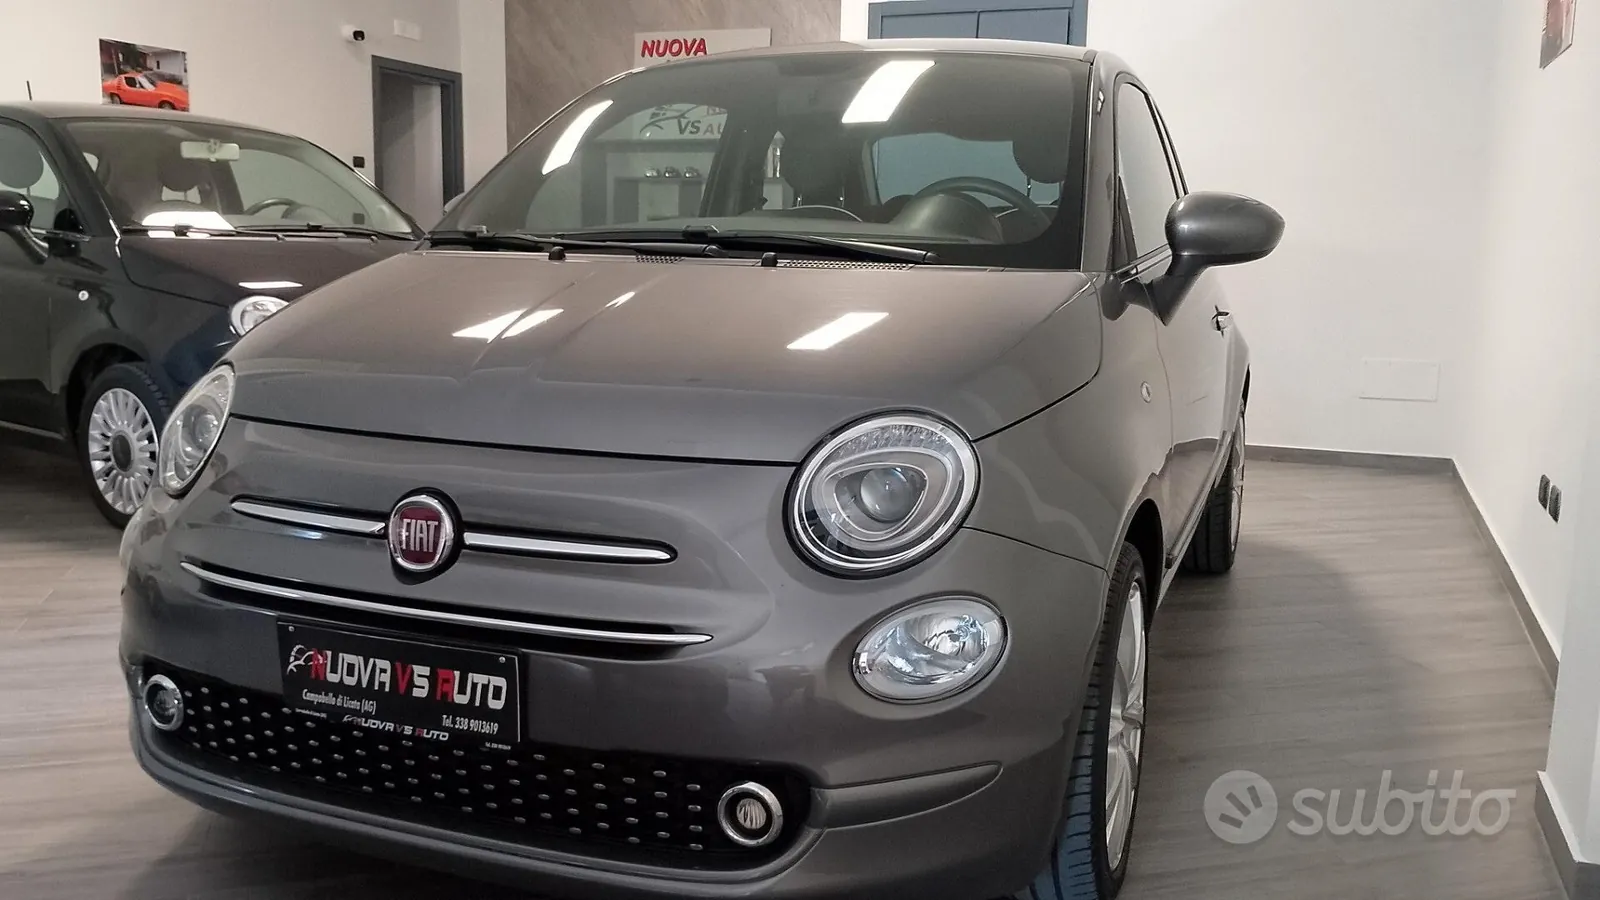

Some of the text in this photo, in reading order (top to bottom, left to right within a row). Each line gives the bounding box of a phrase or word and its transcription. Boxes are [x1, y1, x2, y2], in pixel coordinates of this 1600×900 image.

[641, 37, 707, 57] NUOVA
[677, 119, 702, 135] VS
[402, 518, 439, 552] FIAT
[311, 648, 507, 710] NUOVA VS AUTO
[361, 698, 377, 715] (AG)
[415, 727, 450, 741] AUTO
[455, 716, 469, 730] 338
[469, 719, 499, 735] 9013619
